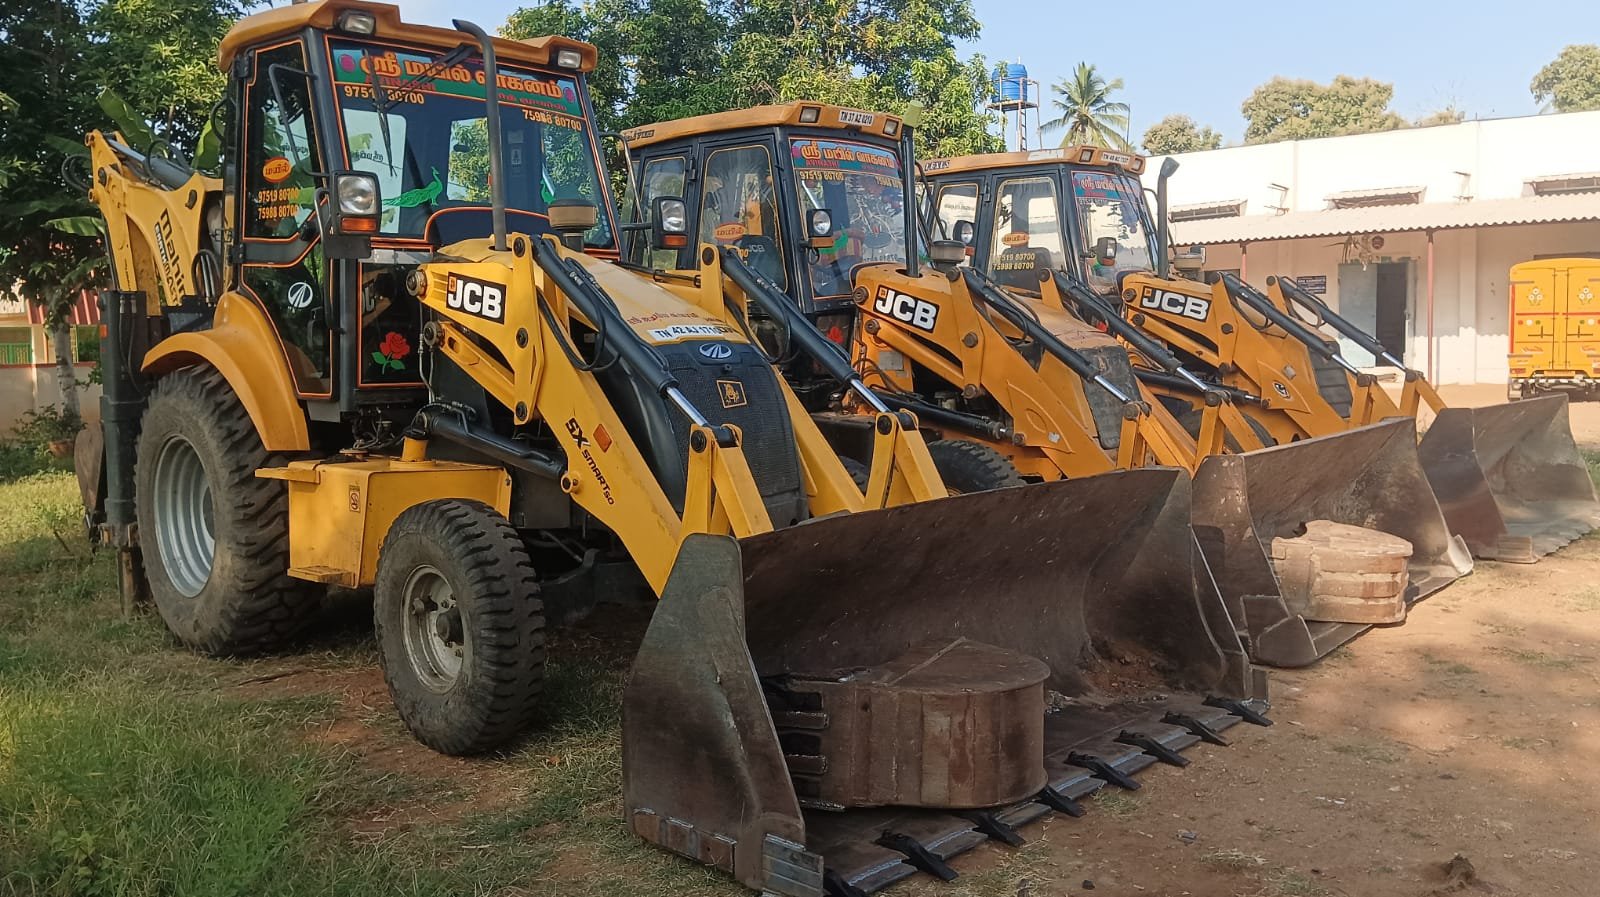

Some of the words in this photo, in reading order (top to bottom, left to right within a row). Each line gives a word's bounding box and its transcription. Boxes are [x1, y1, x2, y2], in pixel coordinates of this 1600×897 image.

[344, 85, 384, 101] 9751
[555, 115, 582, 131] 80700
[448, 279, 502, 319] JCB
[875, 289, 937, 330] JCB
[1142, 290, 1209, 320] JCB
[565, 417, 590, 450] SX
